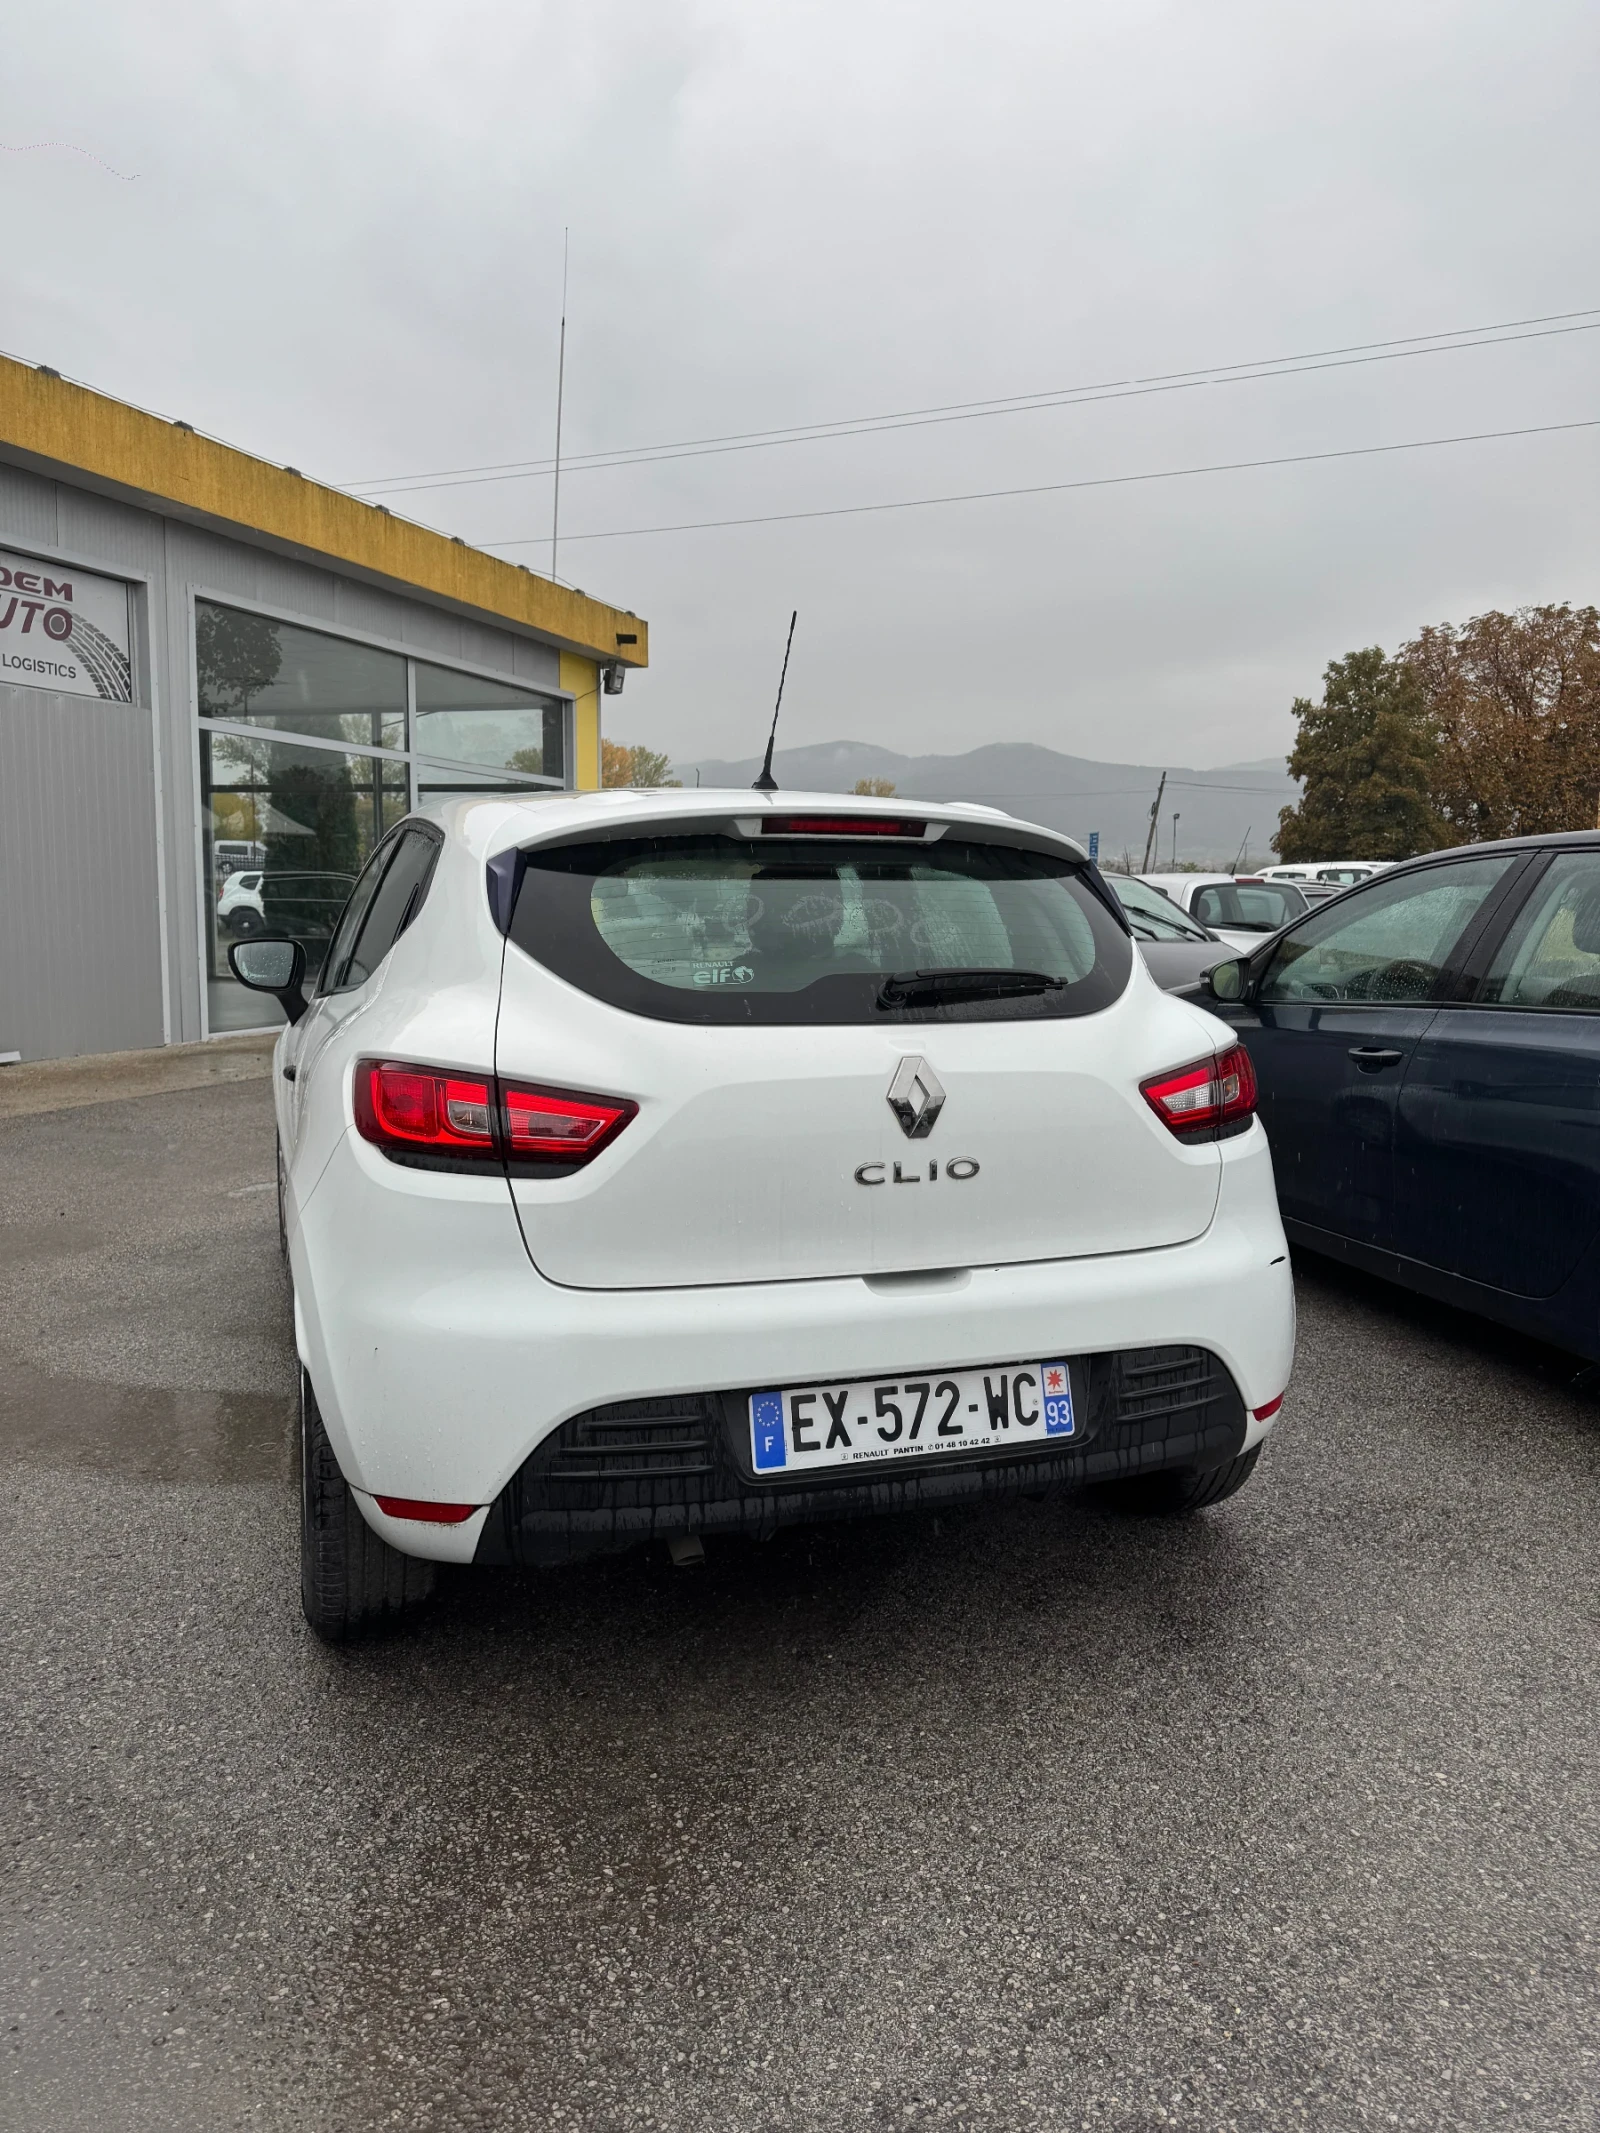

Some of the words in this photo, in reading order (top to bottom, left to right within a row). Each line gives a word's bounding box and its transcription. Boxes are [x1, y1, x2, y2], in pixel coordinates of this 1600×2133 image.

[2, 653, 77, 679] LOGISTICS
[693, 961, 734, 969] RENAULT
[693, 968, 731, 984] elf
[854, 1156, 980, 1185] CLIO
[790, 1372, 1039, 1452] EX-572-WC
[1046, 1400, 1070, 1426] 93
[764, 1435, 774, 1452] F
[852, 1449, 889, 1460] RENAULT
[893, 1445, 924, 1455] PANTIN
[935, 1442, 944, 1450] 01
[946, 1440, 956, 1448] 48
[958, 1439, 967, 1447] 10
[969, 1438, 979, 1446] 42
[980, 1437, 991, 1445] 42
